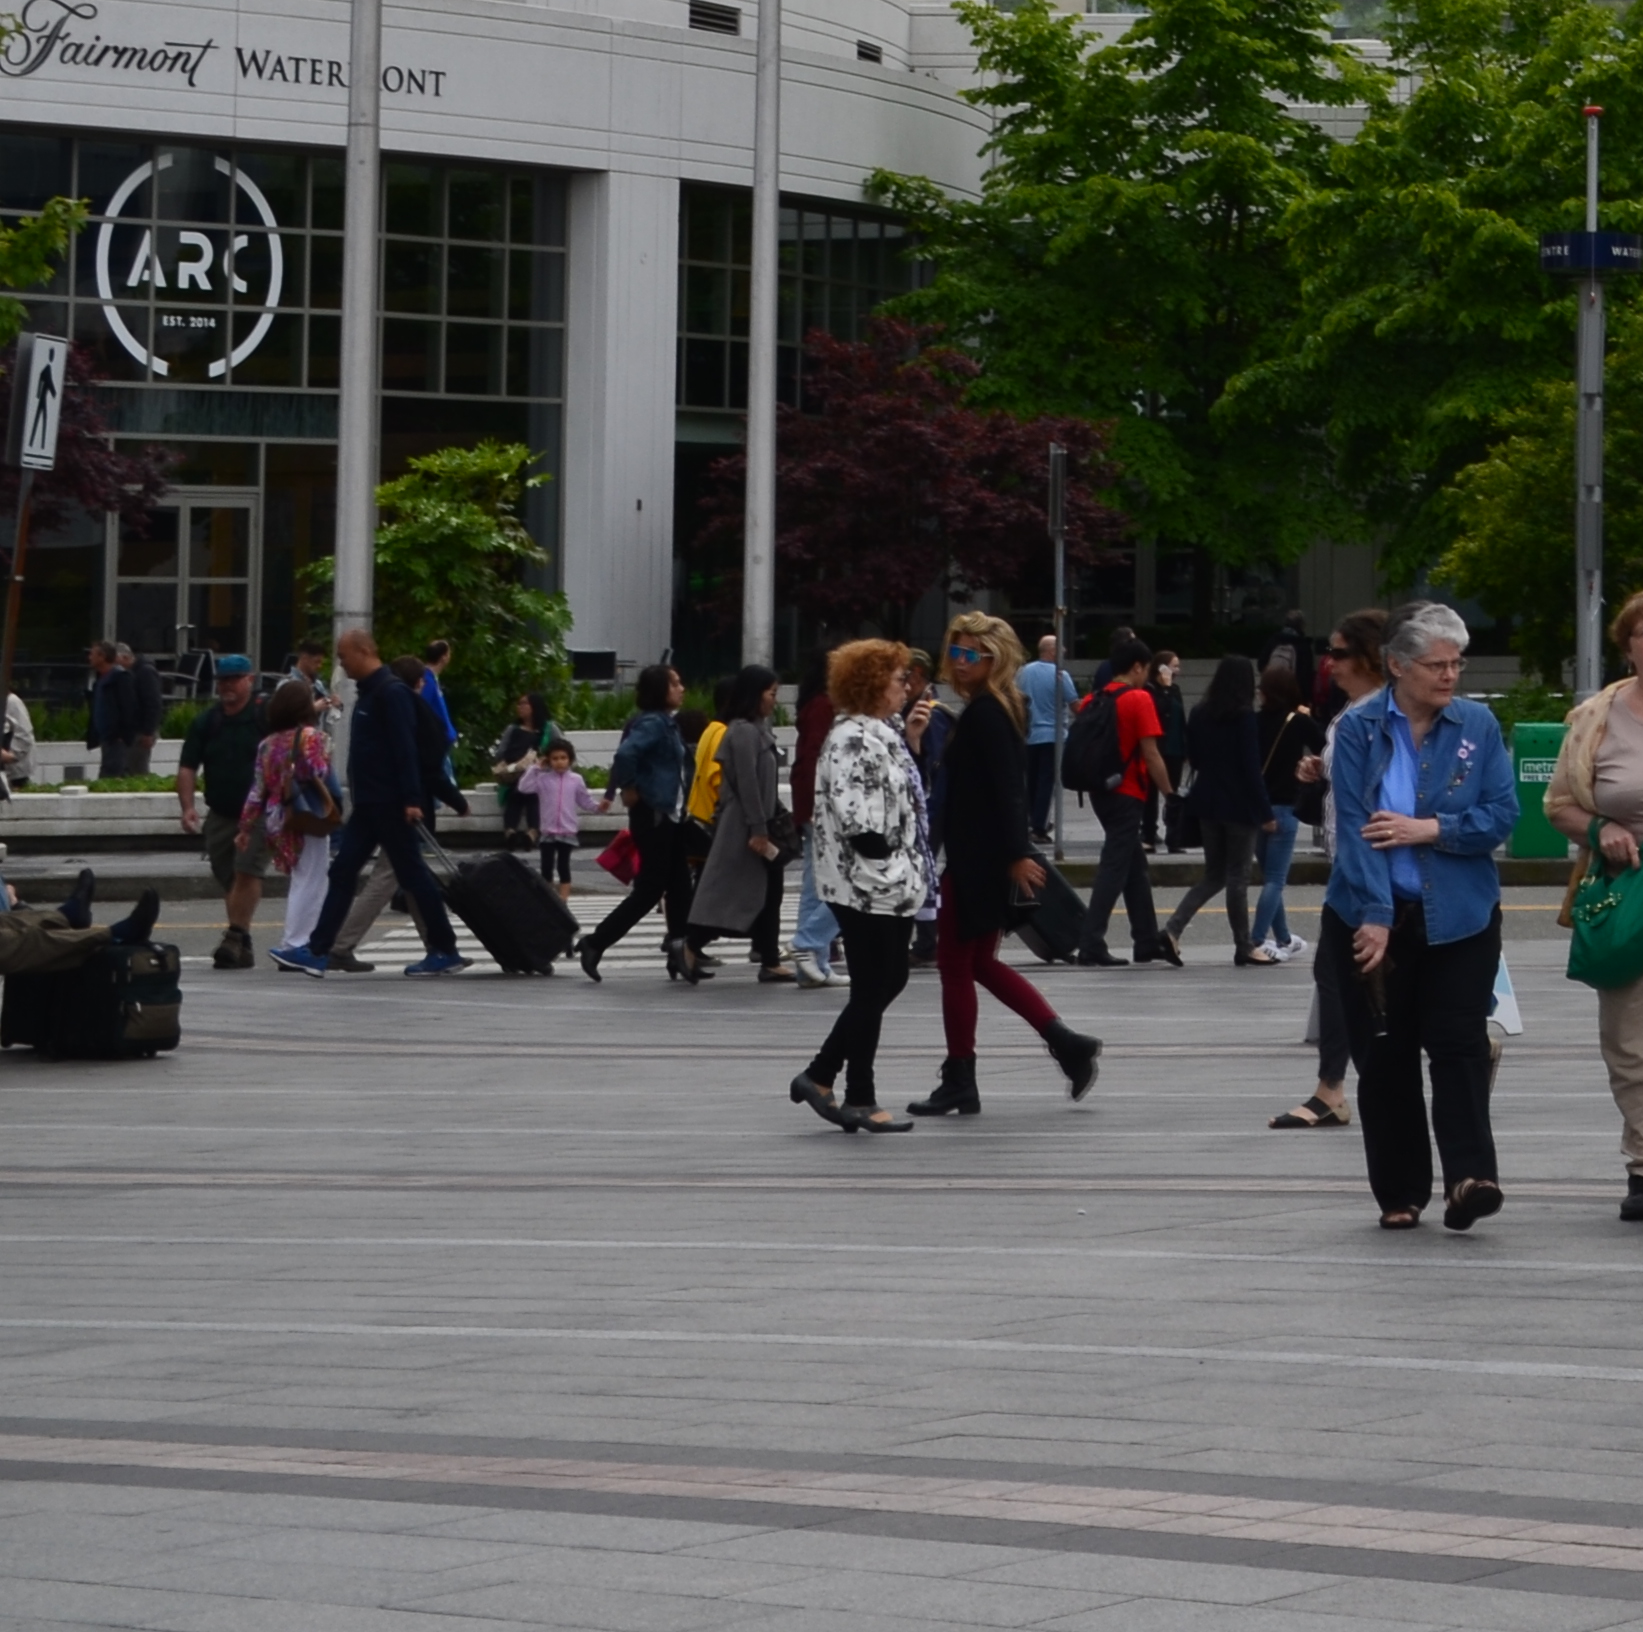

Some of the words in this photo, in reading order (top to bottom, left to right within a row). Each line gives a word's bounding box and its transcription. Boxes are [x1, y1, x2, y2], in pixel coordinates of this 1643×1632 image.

[235, 47, 446, 97] WATERONT
[127, 231, 248, 294] ARC
[163, 315, 186, 327] EST.
[190, 316, 216, 328] 2014
